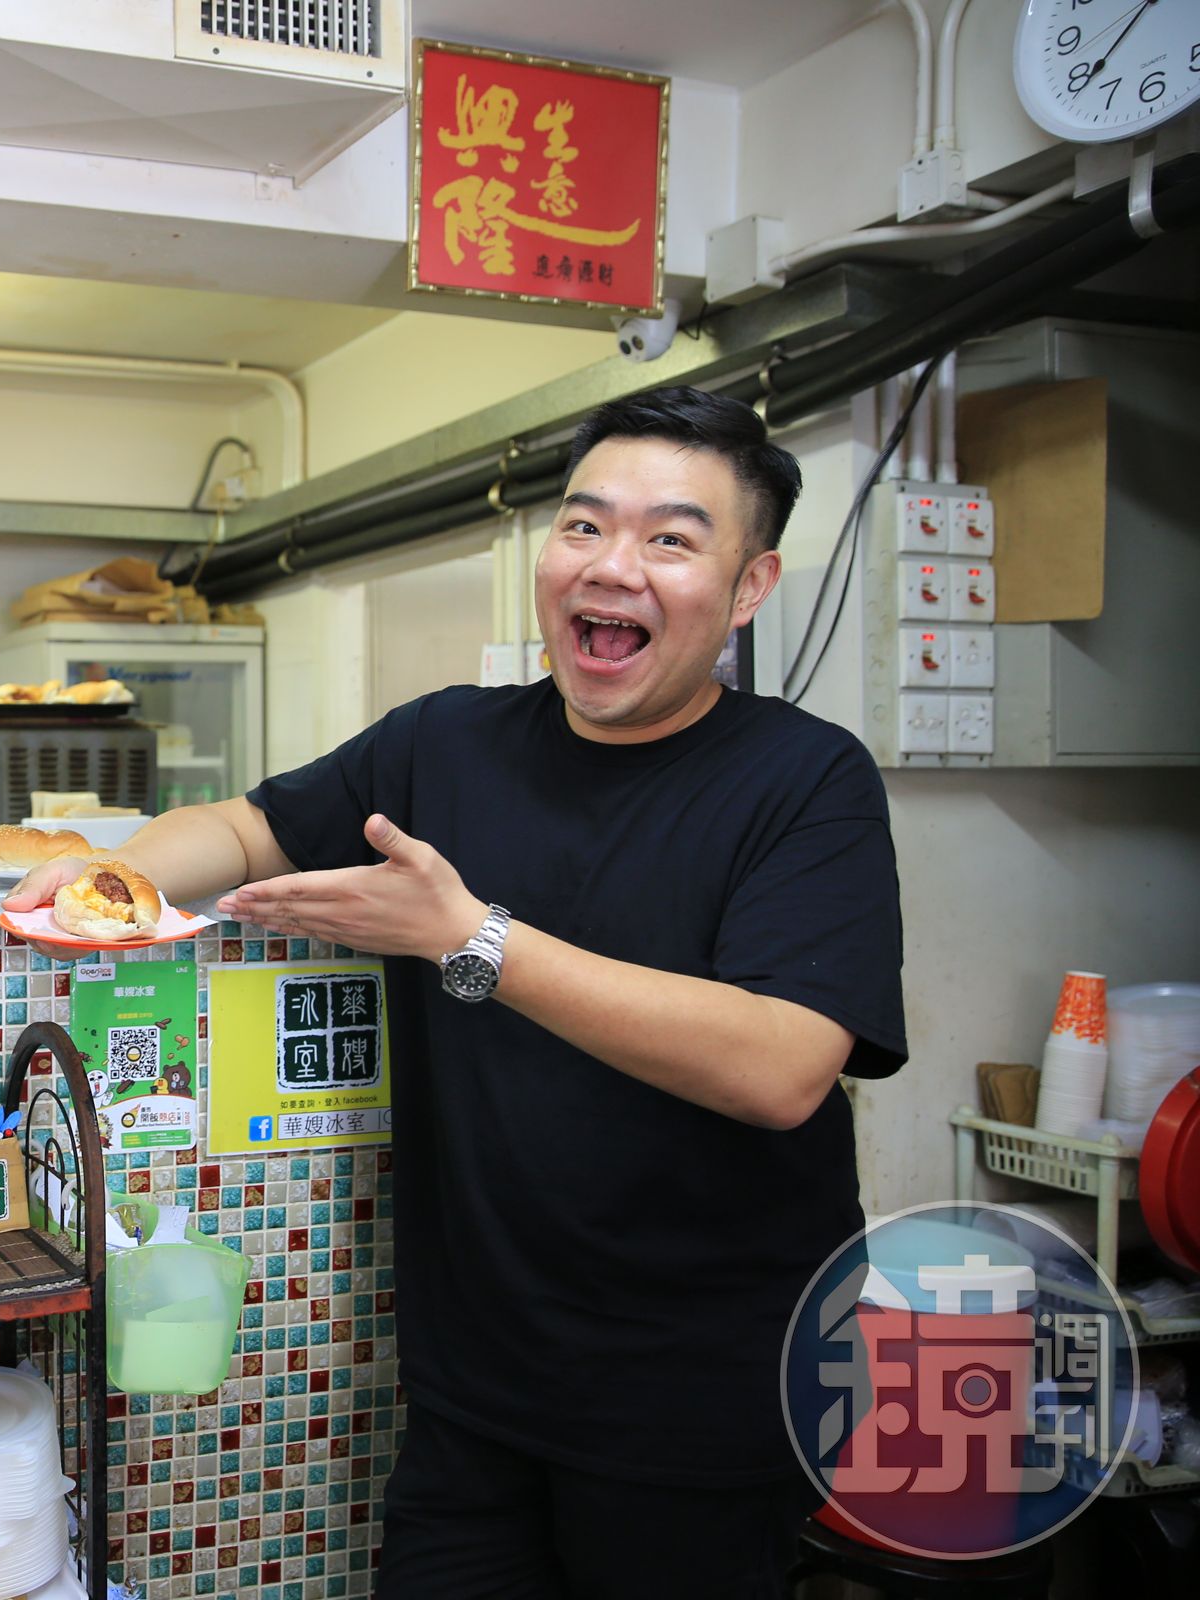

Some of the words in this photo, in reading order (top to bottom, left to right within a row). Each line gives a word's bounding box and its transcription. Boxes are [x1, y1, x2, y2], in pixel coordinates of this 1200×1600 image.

[1057, 26, 1081, 56] 9
[1067, 62, 1090, 93] 8
[1139, 71, 1166, 103] 6
[1099, 78, 1122, 110] 7
[343, 1096, 378, 1104] facebook
[285, 1112, 365, 1136] 華嫂冰室
